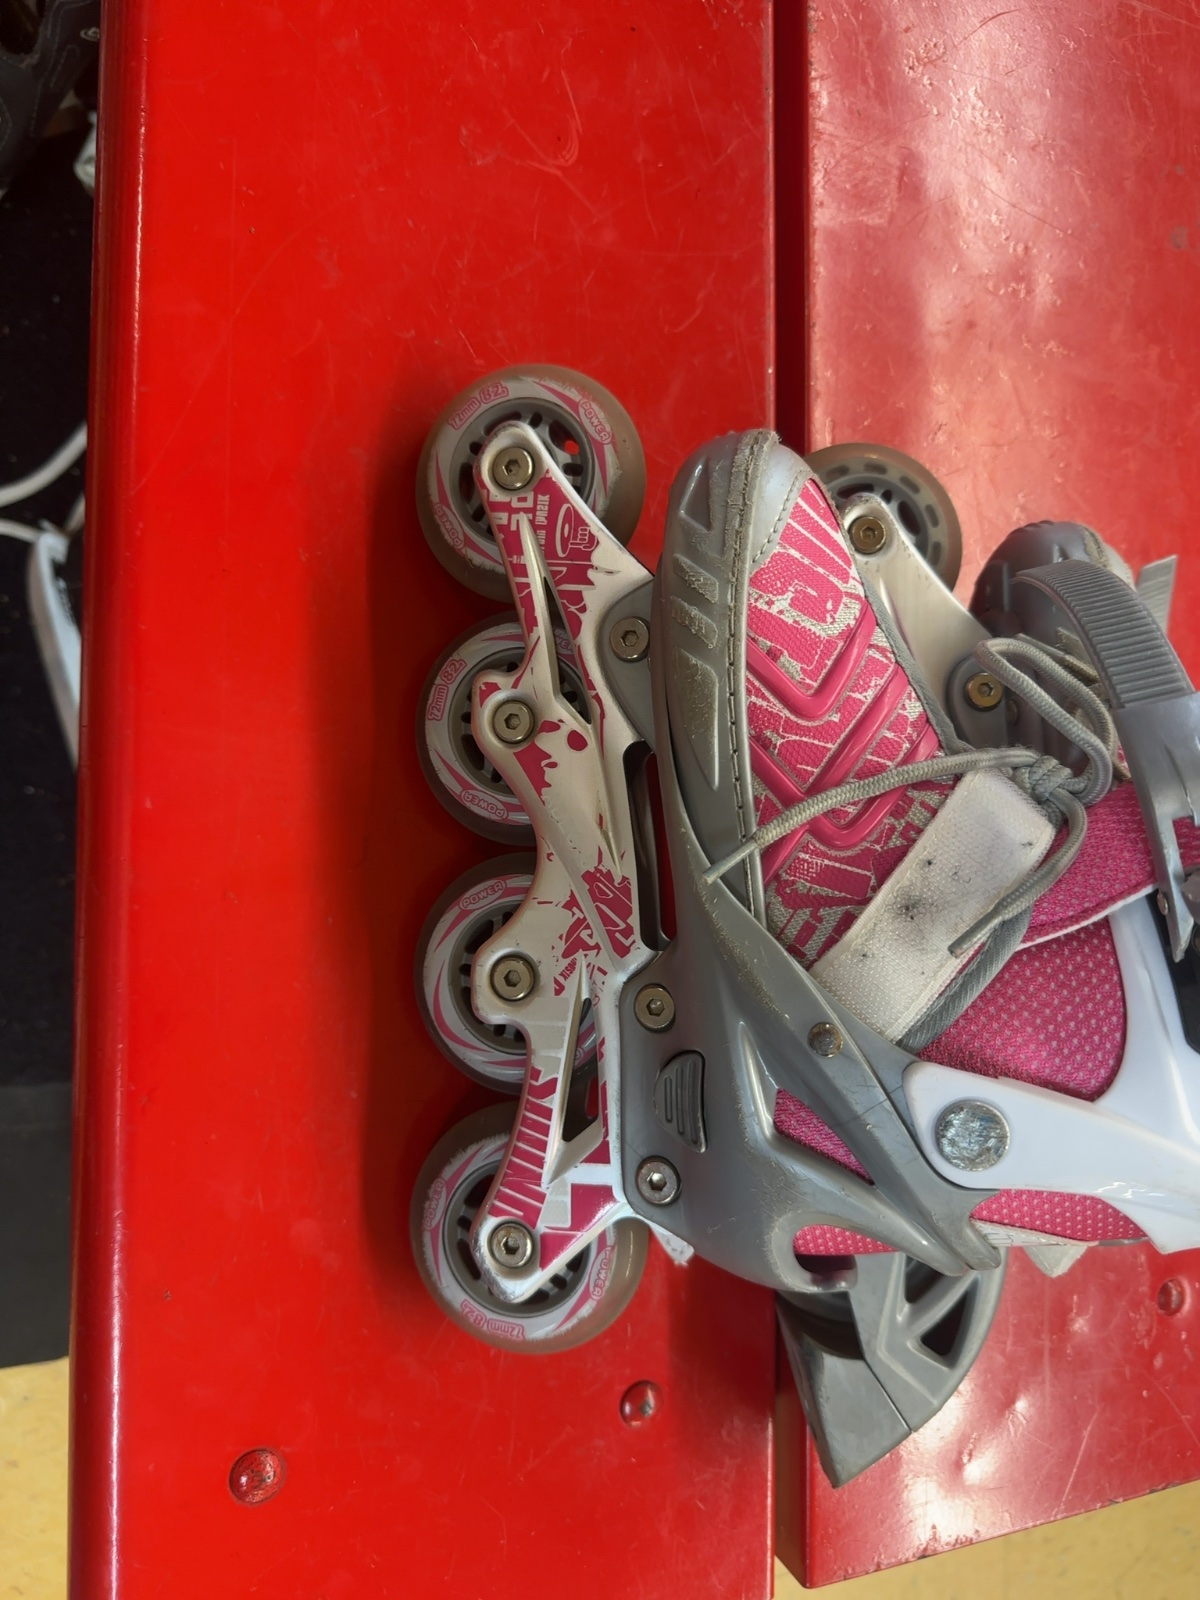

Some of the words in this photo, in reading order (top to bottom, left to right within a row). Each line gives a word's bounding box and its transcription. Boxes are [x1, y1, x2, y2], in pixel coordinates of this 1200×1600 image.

[449, 399, 481, 430] 72mm
[579, 398, 611, 443] POWER
[434, 501, 463, 549] POWER
[427, 684, 449, 721] 72mm
[462, 791, 508, 818] POWER
[461, 881, 505, 909] POWER
[425, 1177, 445, 1230] POWER
[487, 1319, 526, 1341] 72mm
